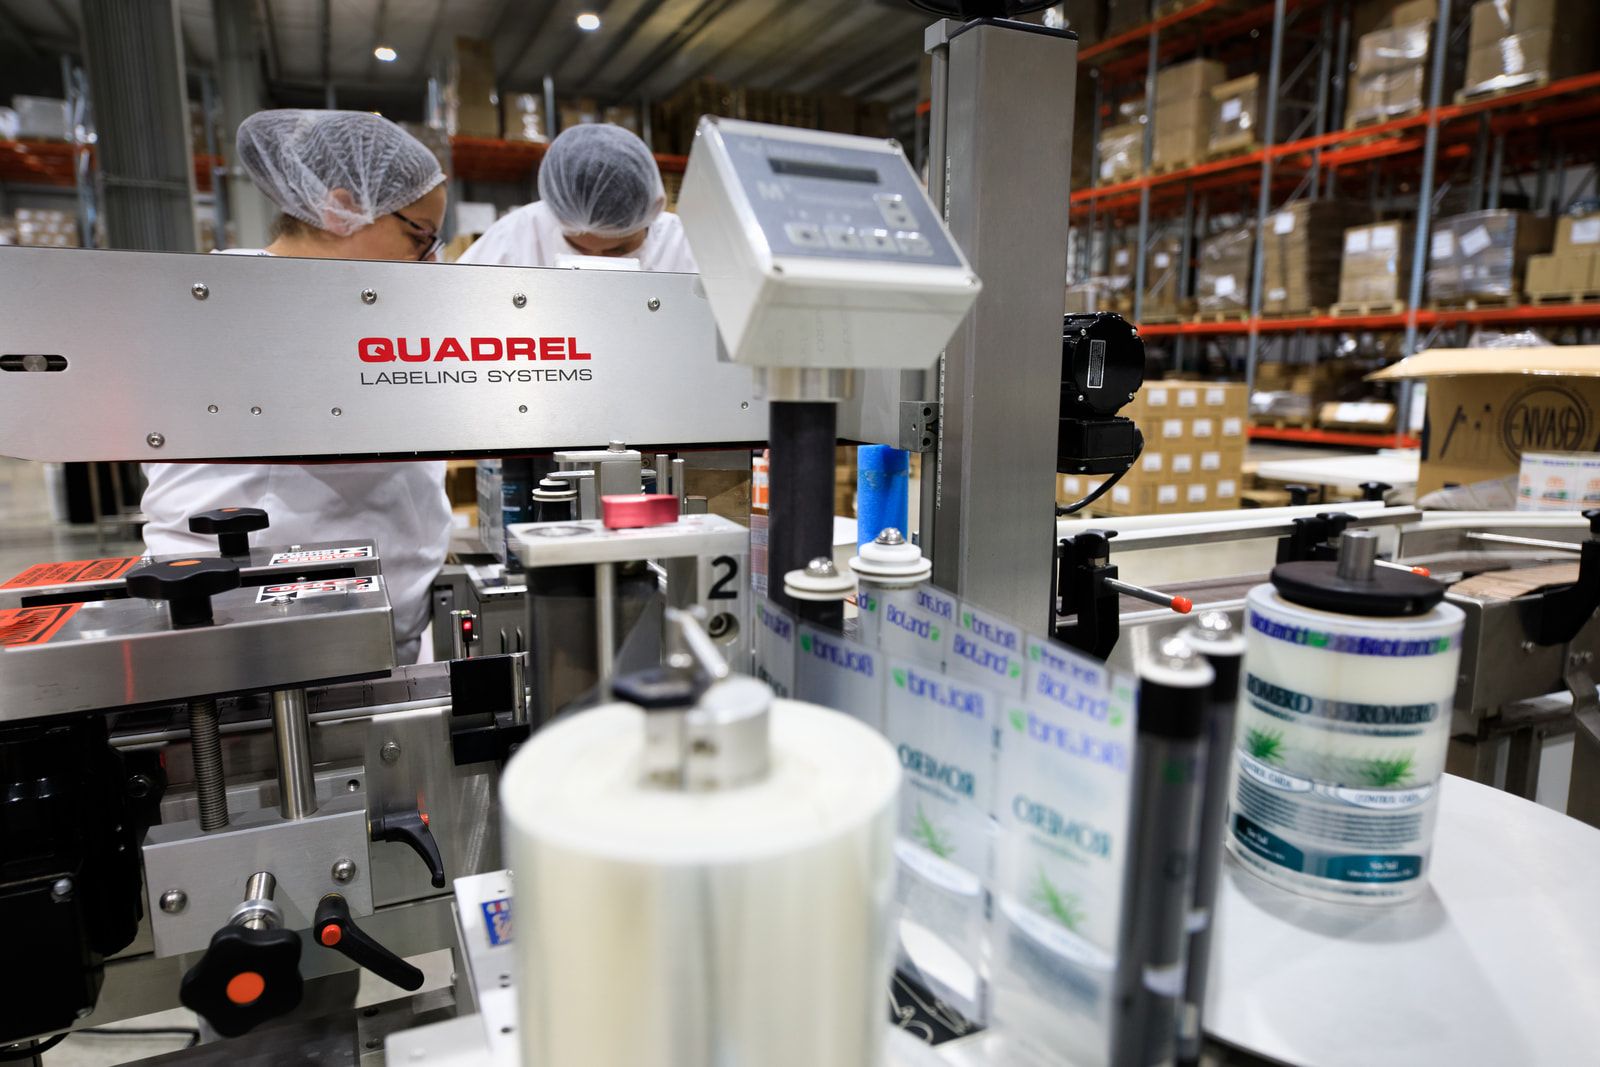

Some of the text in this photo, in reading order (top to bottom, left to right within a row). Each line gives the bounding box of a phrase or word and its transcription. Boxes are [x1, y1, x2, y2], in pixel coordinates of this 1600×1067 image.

[358, 337, 591, 363] QUADREL
[361, 368, 592, 386] LABELING SYSTEMS
[708, 556, 738, 600] 2
